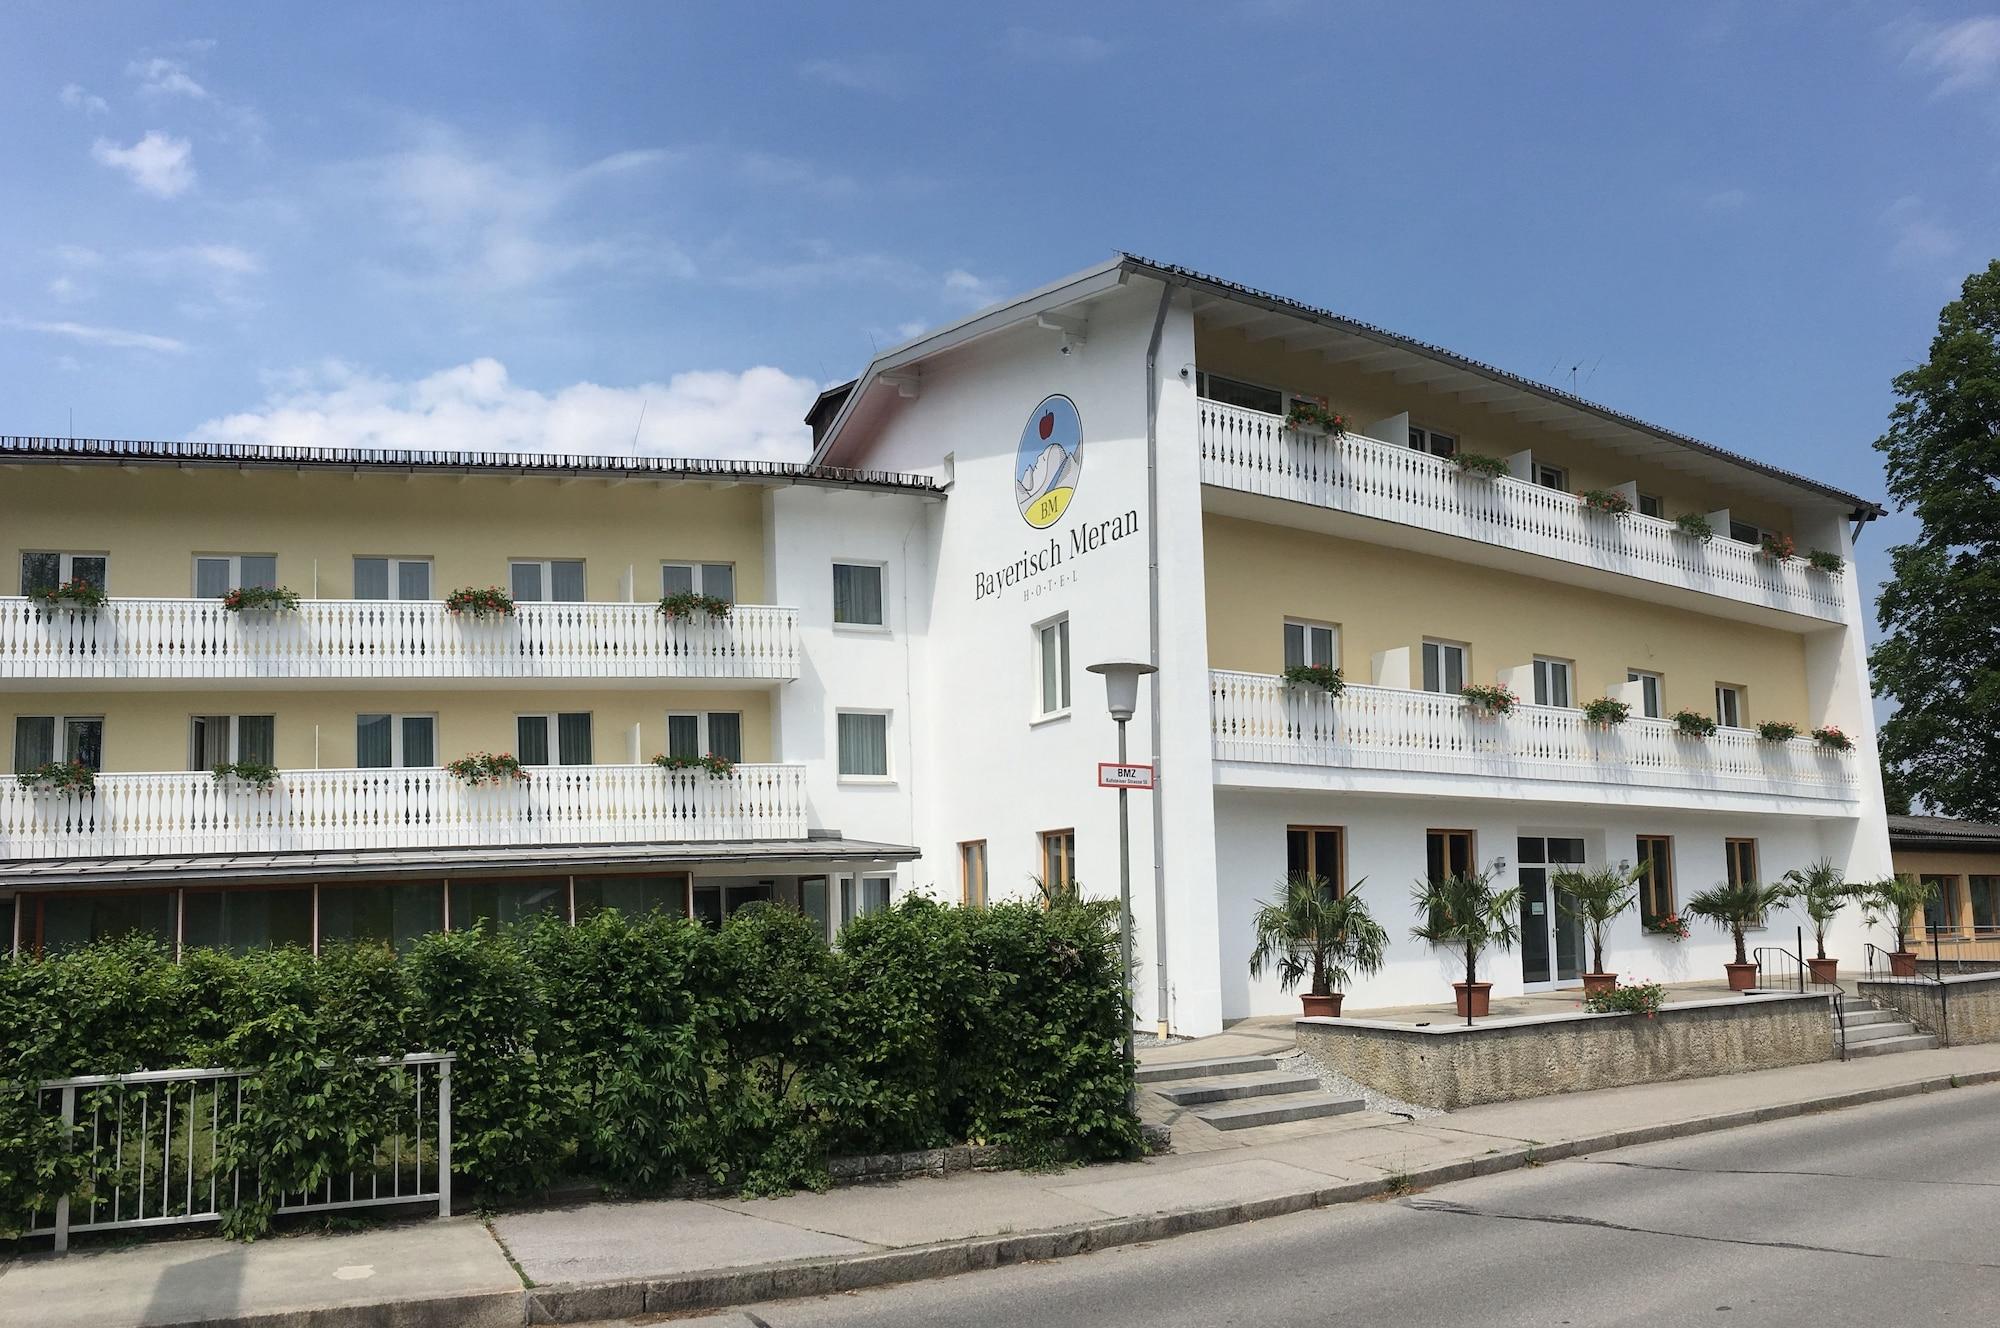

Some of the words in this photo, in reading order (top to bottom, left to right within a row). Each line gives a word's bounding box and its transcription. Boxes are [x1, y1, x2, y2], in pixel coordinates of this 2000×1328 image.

[1041, 496, 1058, 520] BM
[975, 538, 1062, 601] Bayerisch
[1069, 509, 1139, 560] Meran
[1117, 768, 1136, 778] BMZ
